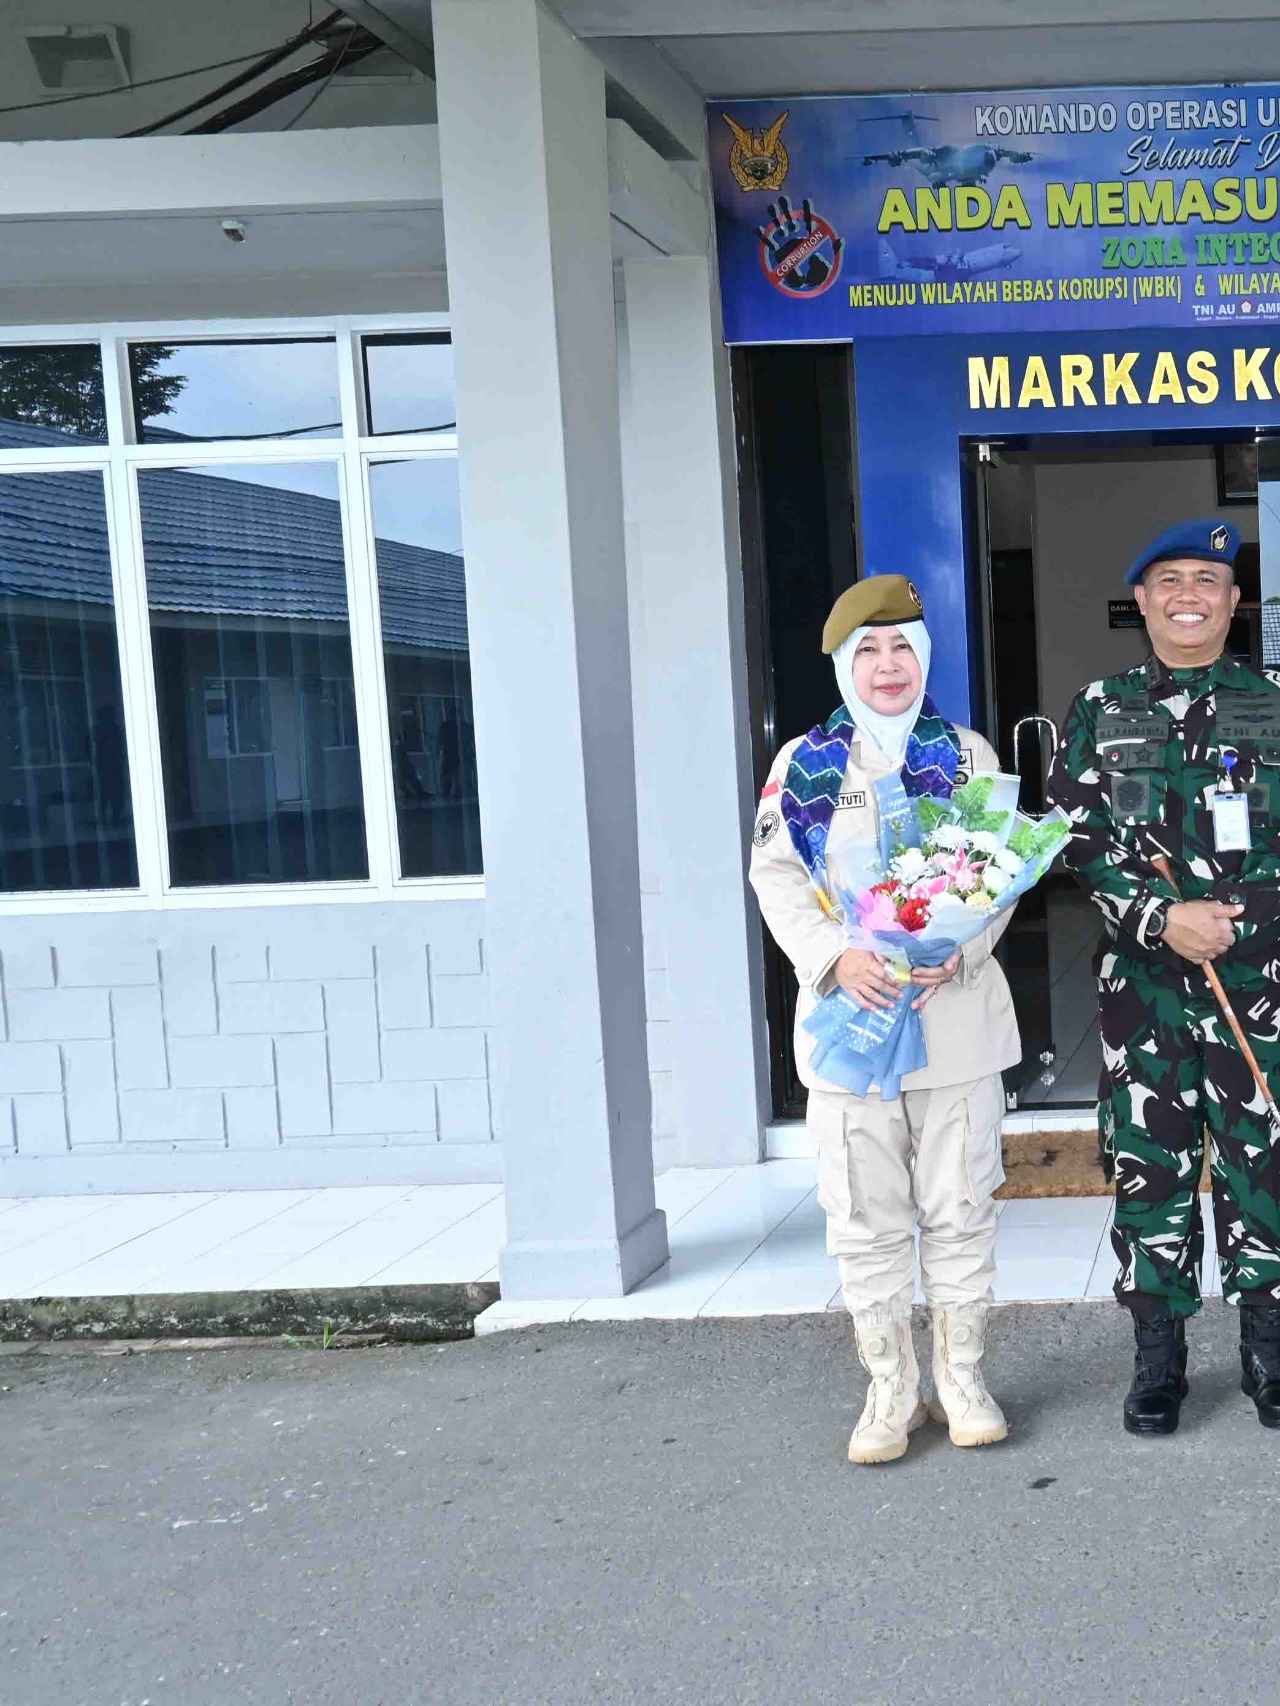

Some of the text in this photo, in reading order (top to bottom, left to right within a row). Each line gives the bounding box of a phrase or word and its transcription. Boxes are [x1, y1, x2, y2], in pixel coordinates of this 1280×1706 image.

[974, 102, 1117, 135] KOMANDO
[1126, 98, 1247, 131] OPERASI
[1119, 134, 1252, 174] Selamat
[877, 184, 1032, 233] ANDA
[776, 230, 824, 277] CORRUPTION
[1101, 234, 1188, 269] ZONA
[849, 283, 917, 308] MENUJU
[920, 279, 998, 305] WILAYAH
[1002, 277, 1054, 302] BEBAS
[1058, 275, 1128, 301] KORUPSI
[1132, 274, 1182, 305] (WBK)
[1194, 273, 1207, 297] &
[1192, 304, 1214, 315] TNI
[1218, 303, 1236, 315] AU
[967, 349, 1220, 409] MARKAS
[1222, 725, 1250, 737] TNI
